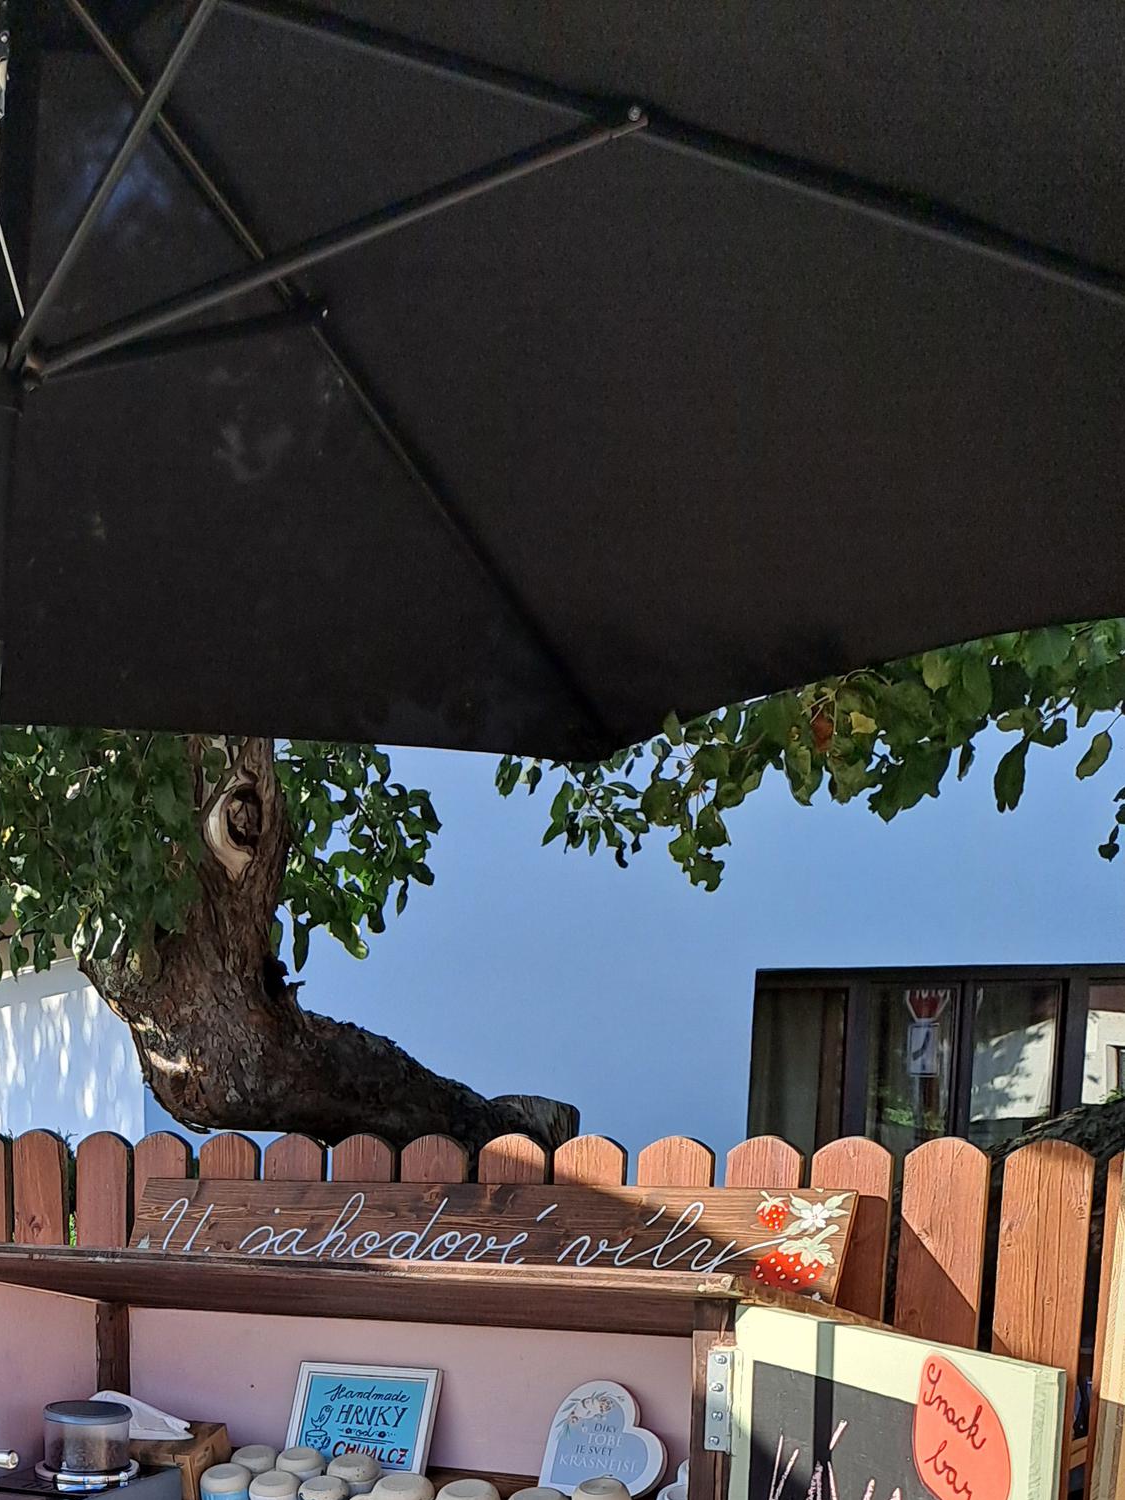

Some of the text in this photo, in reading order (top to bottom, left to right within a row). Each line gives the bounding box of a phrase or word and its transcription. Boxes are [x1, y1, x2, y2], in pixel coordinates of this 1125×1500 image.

[323, 1383, 411, 1403] Handmade
[334, 1403, 409, 1429] HRNKY
[922, 1362, 987, 1450] Snack
[355, 1426, 375, 1438] od
